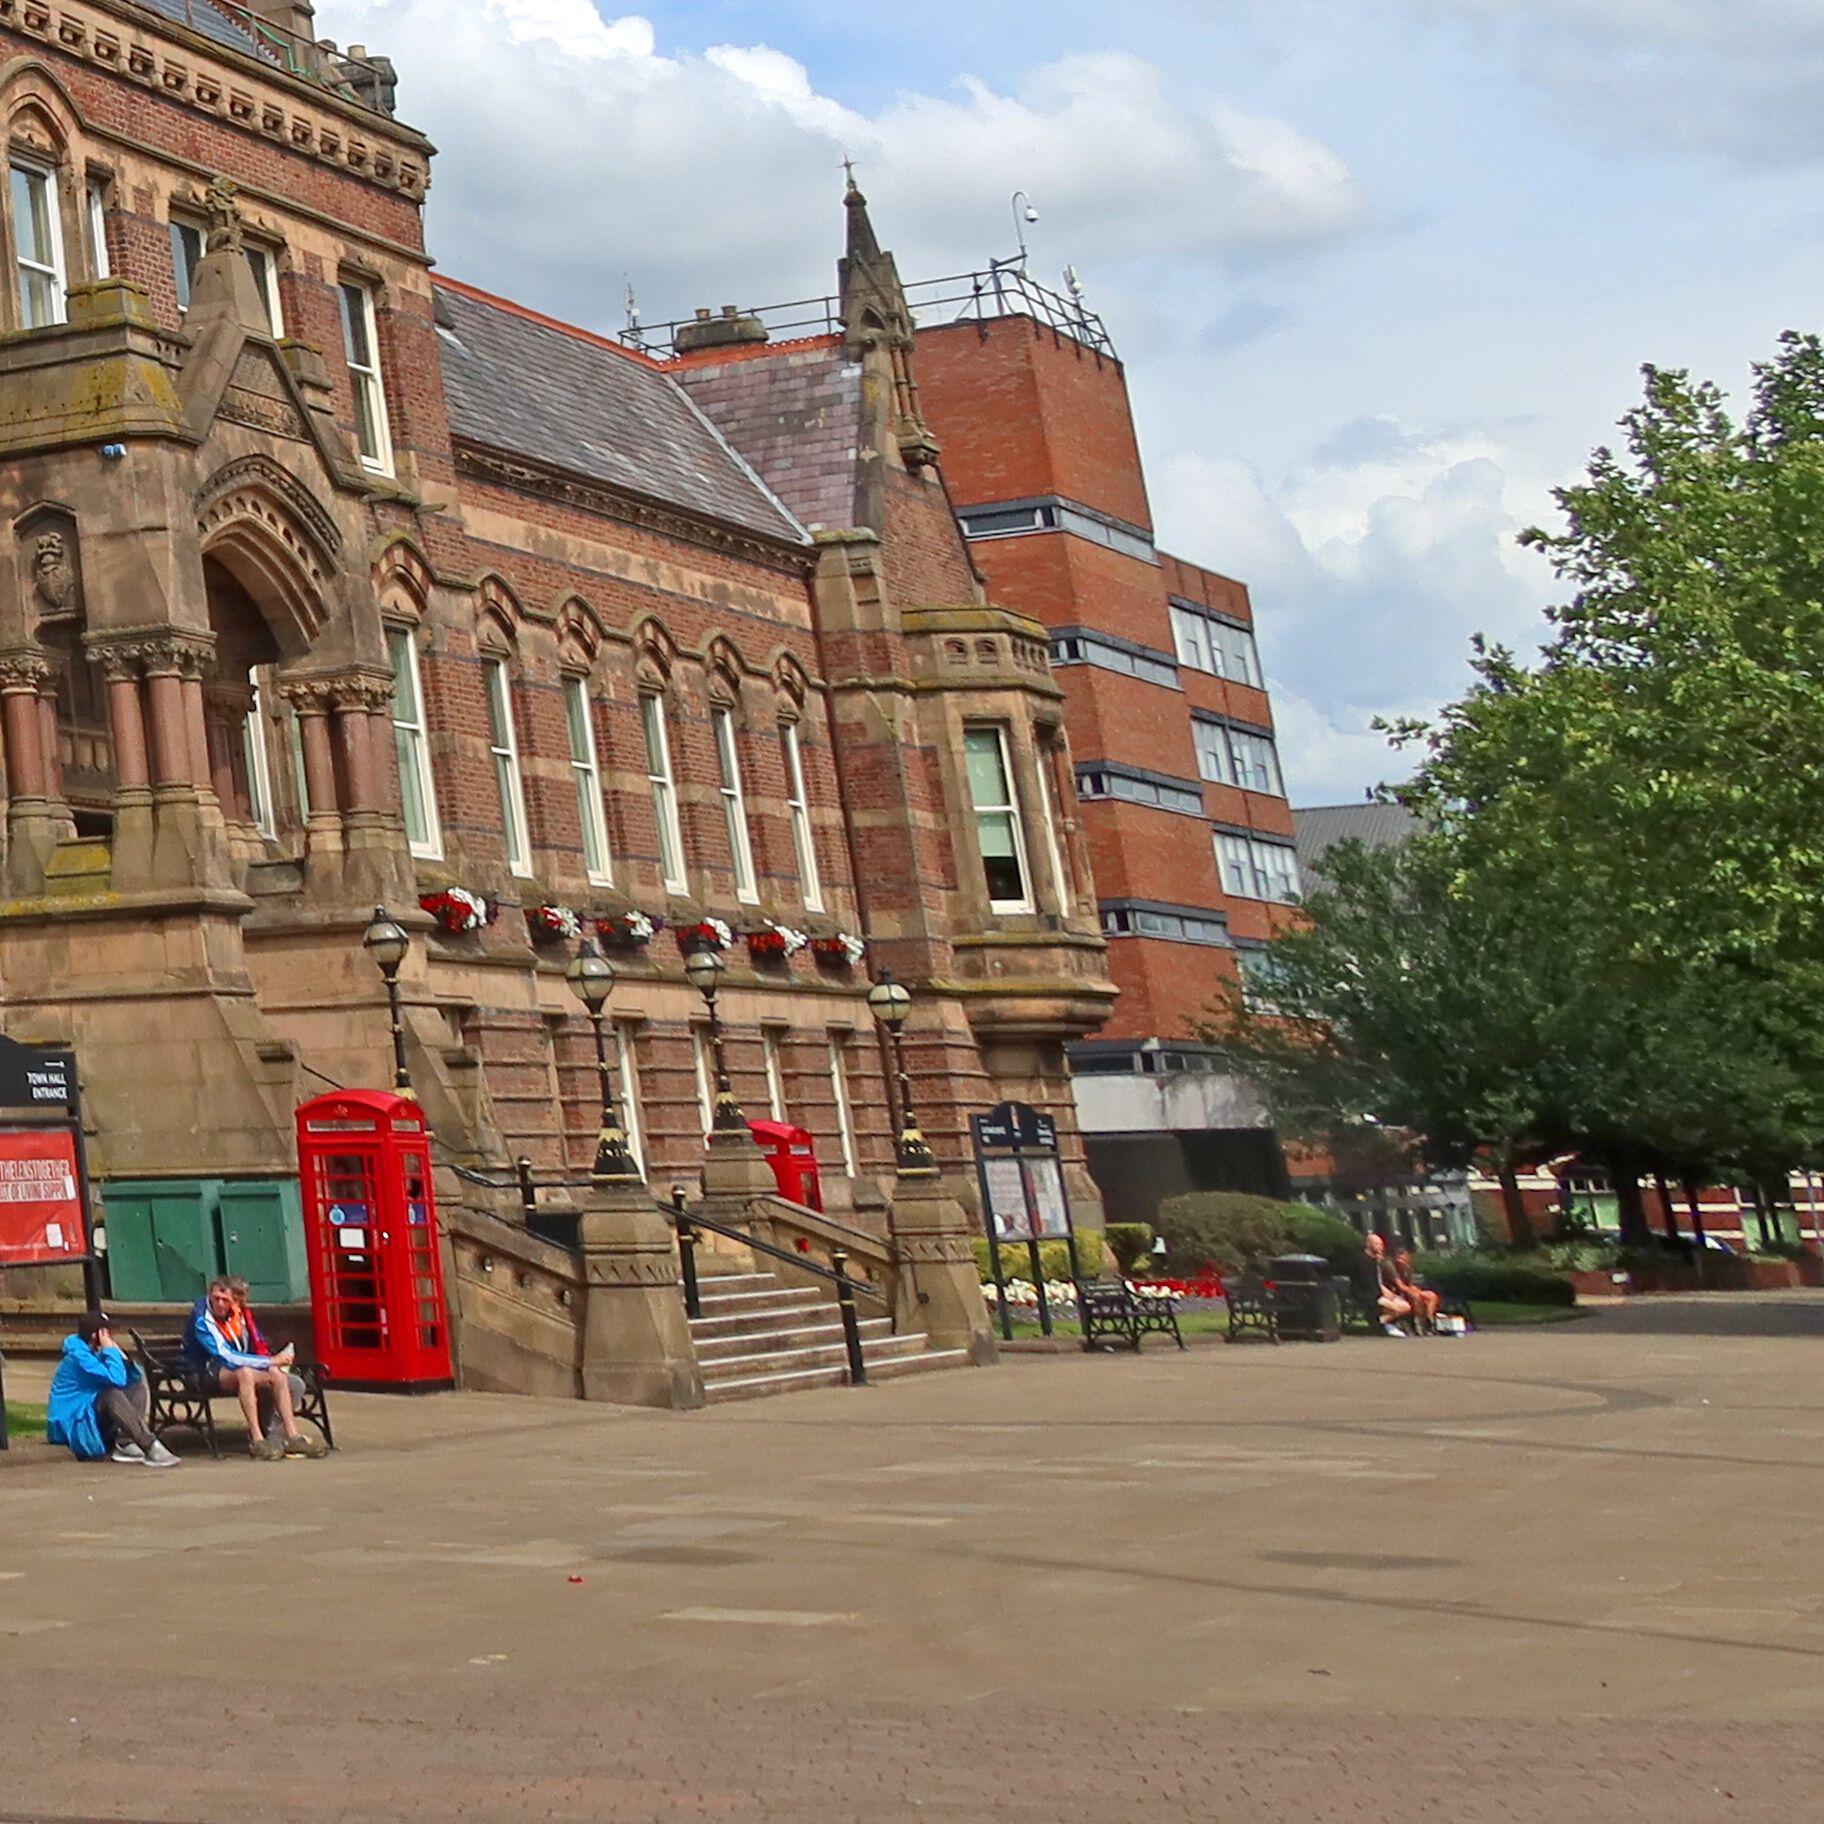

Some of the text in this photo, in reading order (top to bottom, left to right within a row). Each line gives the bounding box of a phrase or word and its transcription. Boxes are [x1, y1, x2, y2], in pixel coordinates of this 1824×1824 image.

[26, 1071, 67, 1085] TOWN HALL
[32, 1087, 68, 1099] ENTRANCE
